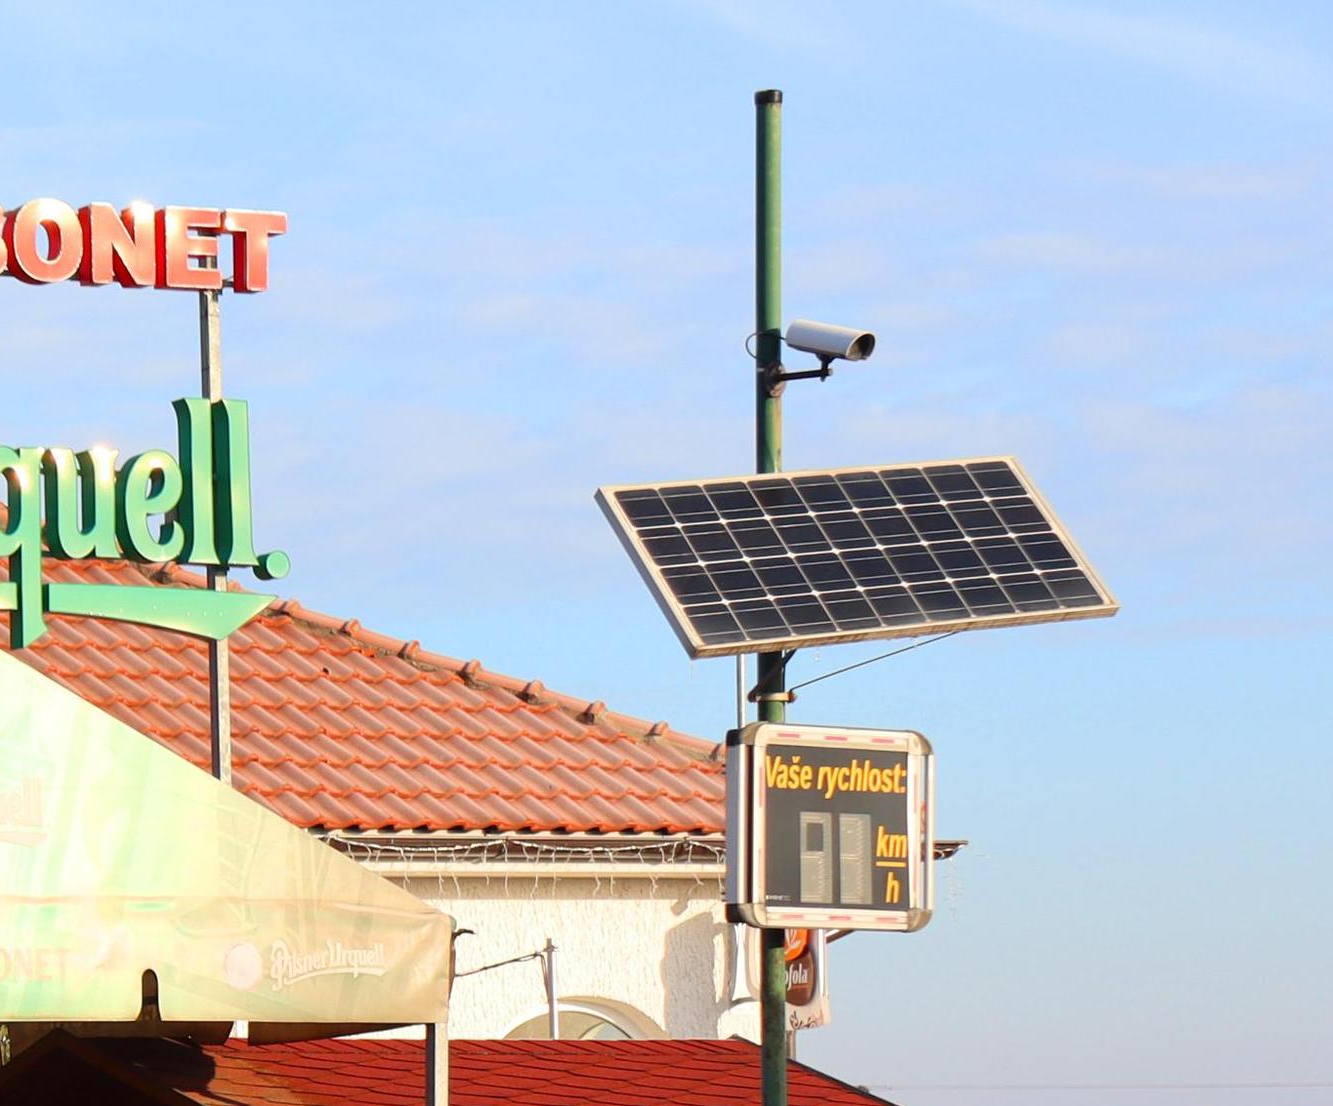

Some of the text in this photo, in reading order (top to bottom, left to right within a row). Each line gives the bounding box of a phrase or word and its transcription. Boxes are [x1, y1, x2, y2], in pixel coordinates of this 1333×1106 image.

[765, 755, 907, 799] Vaše rychlost:
[876, 826, 907, 858] km
[885, 872, 900, 904] h
[270, 938, 385, 992] Pilsner Urquell
